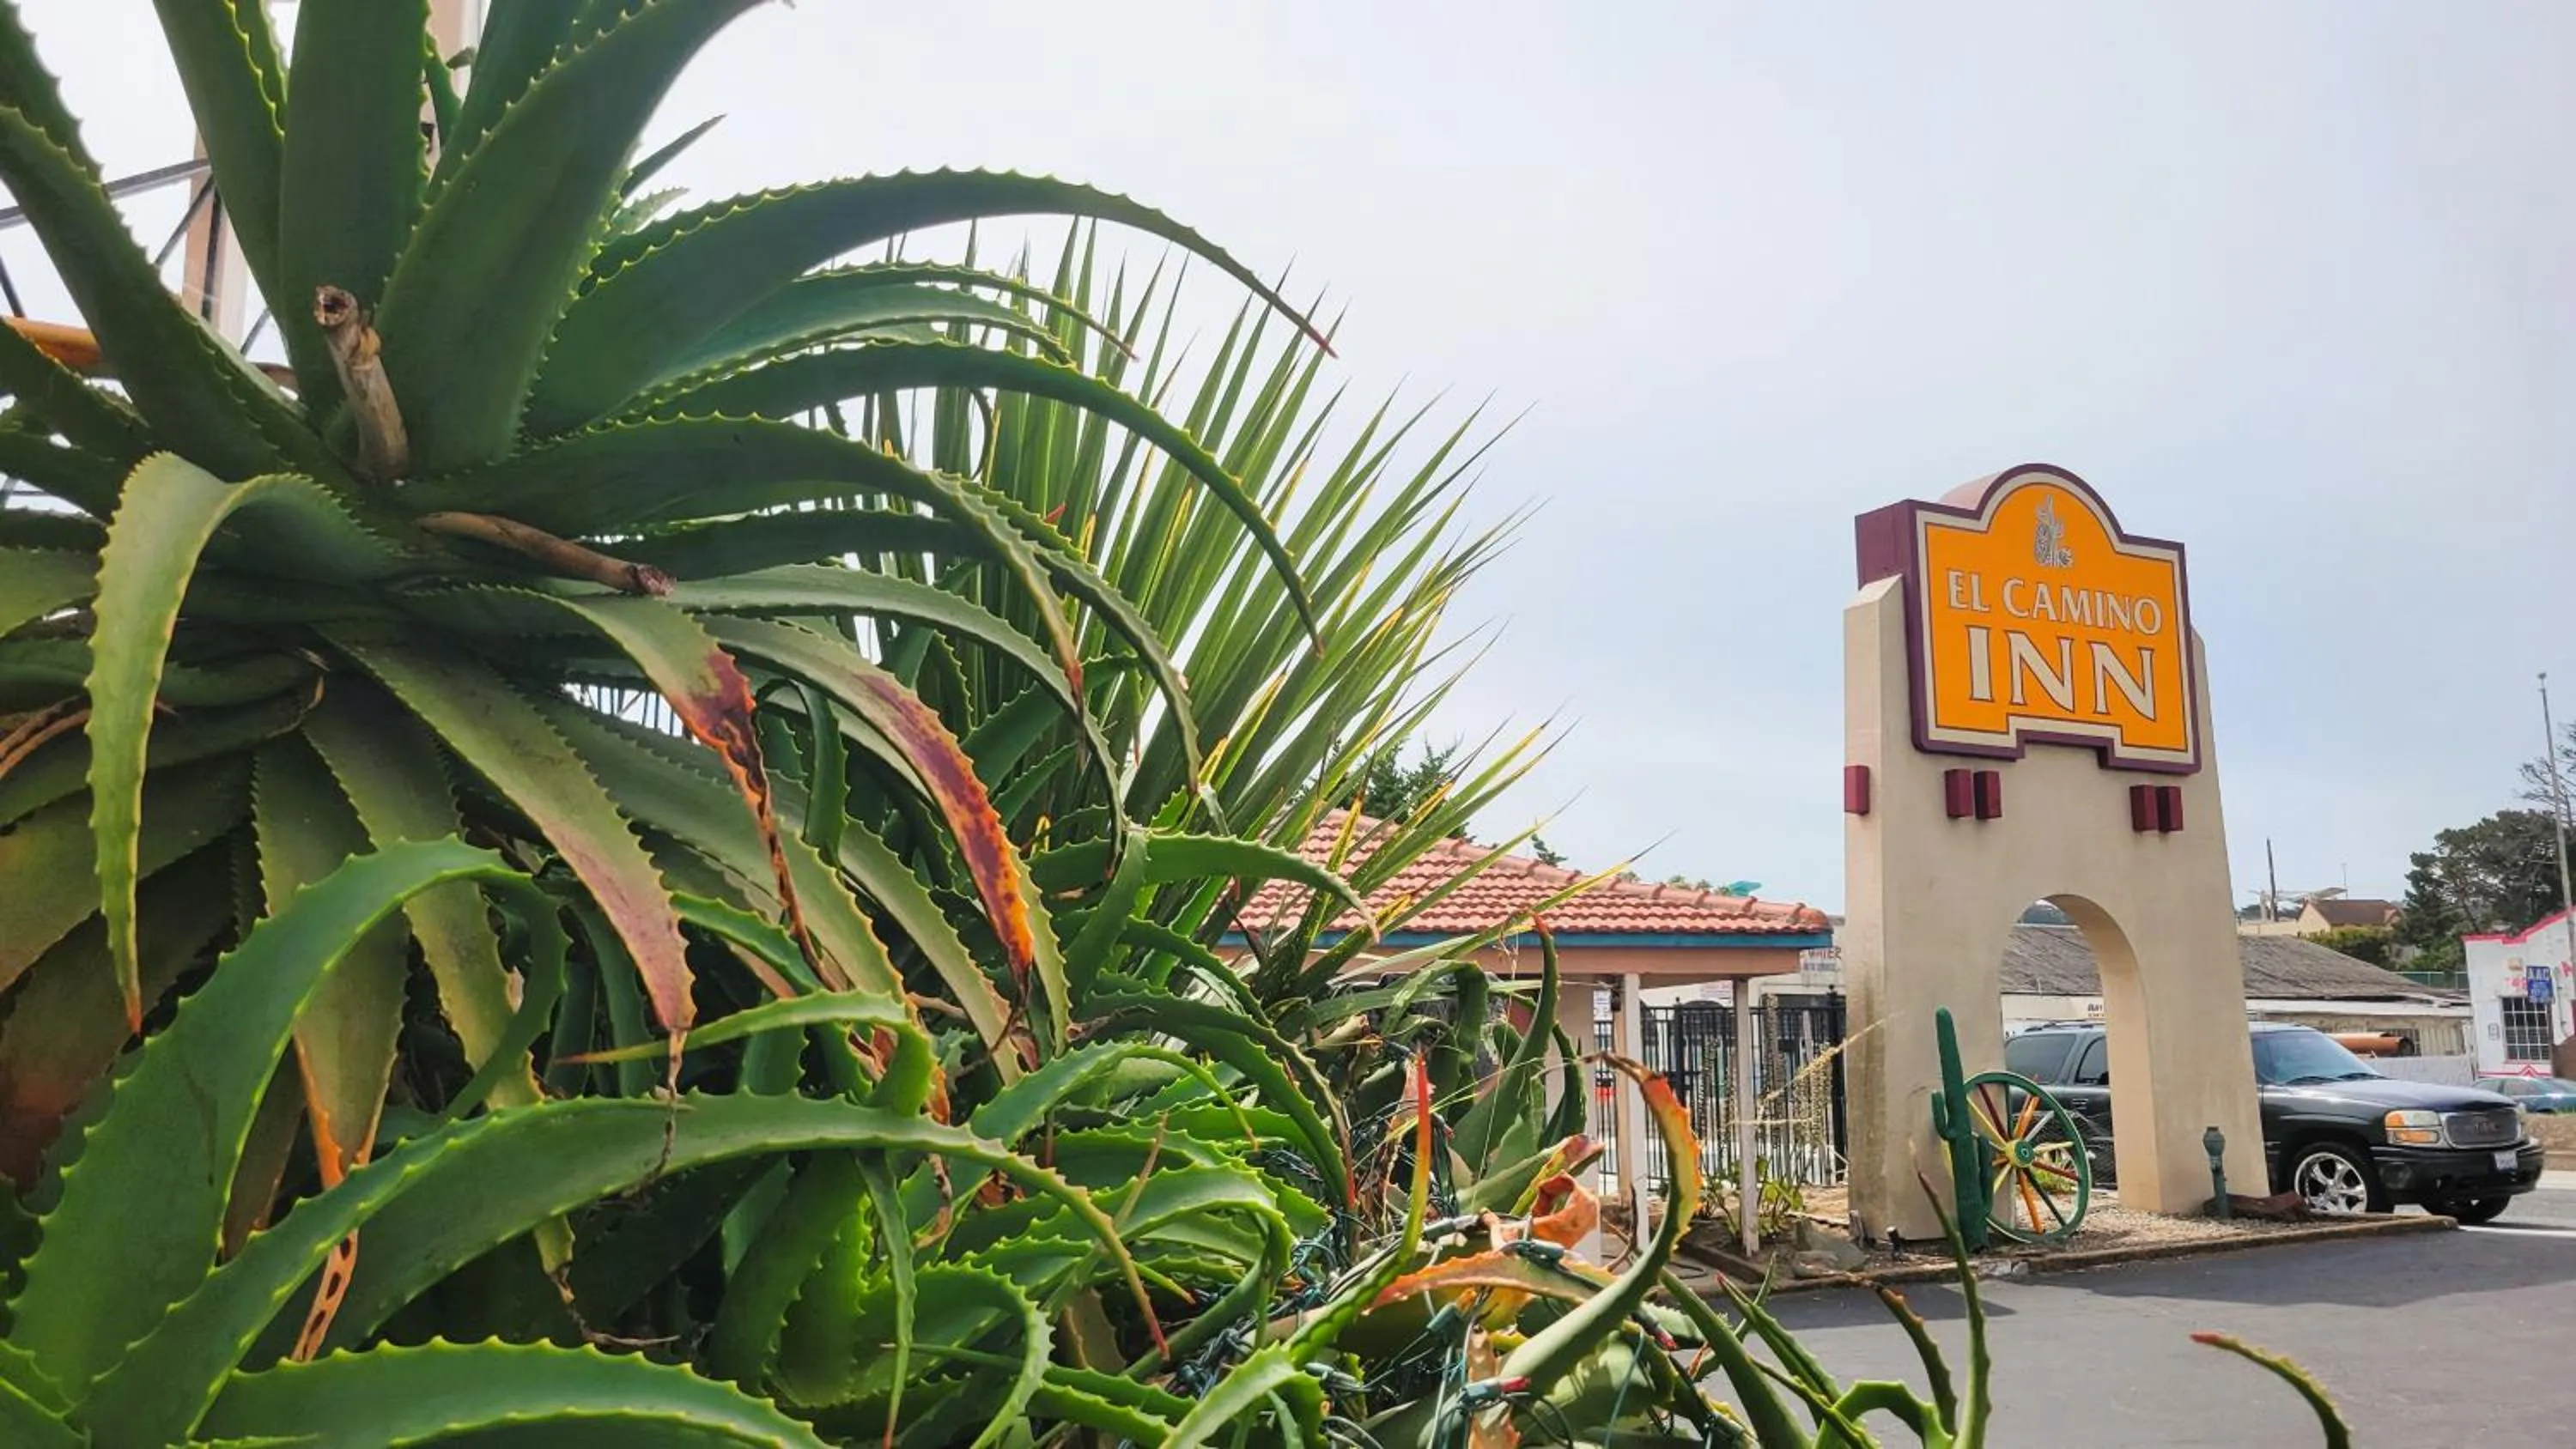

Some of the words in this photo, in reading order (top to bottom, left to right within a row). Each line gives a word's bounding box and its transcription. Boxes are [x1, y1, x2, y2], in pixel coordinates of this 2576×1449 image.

[1947, 567, 1991, 613] EL
[2002, 577, 2162, 636] CAMINO
[1965, 624, 2157, 723] INN
